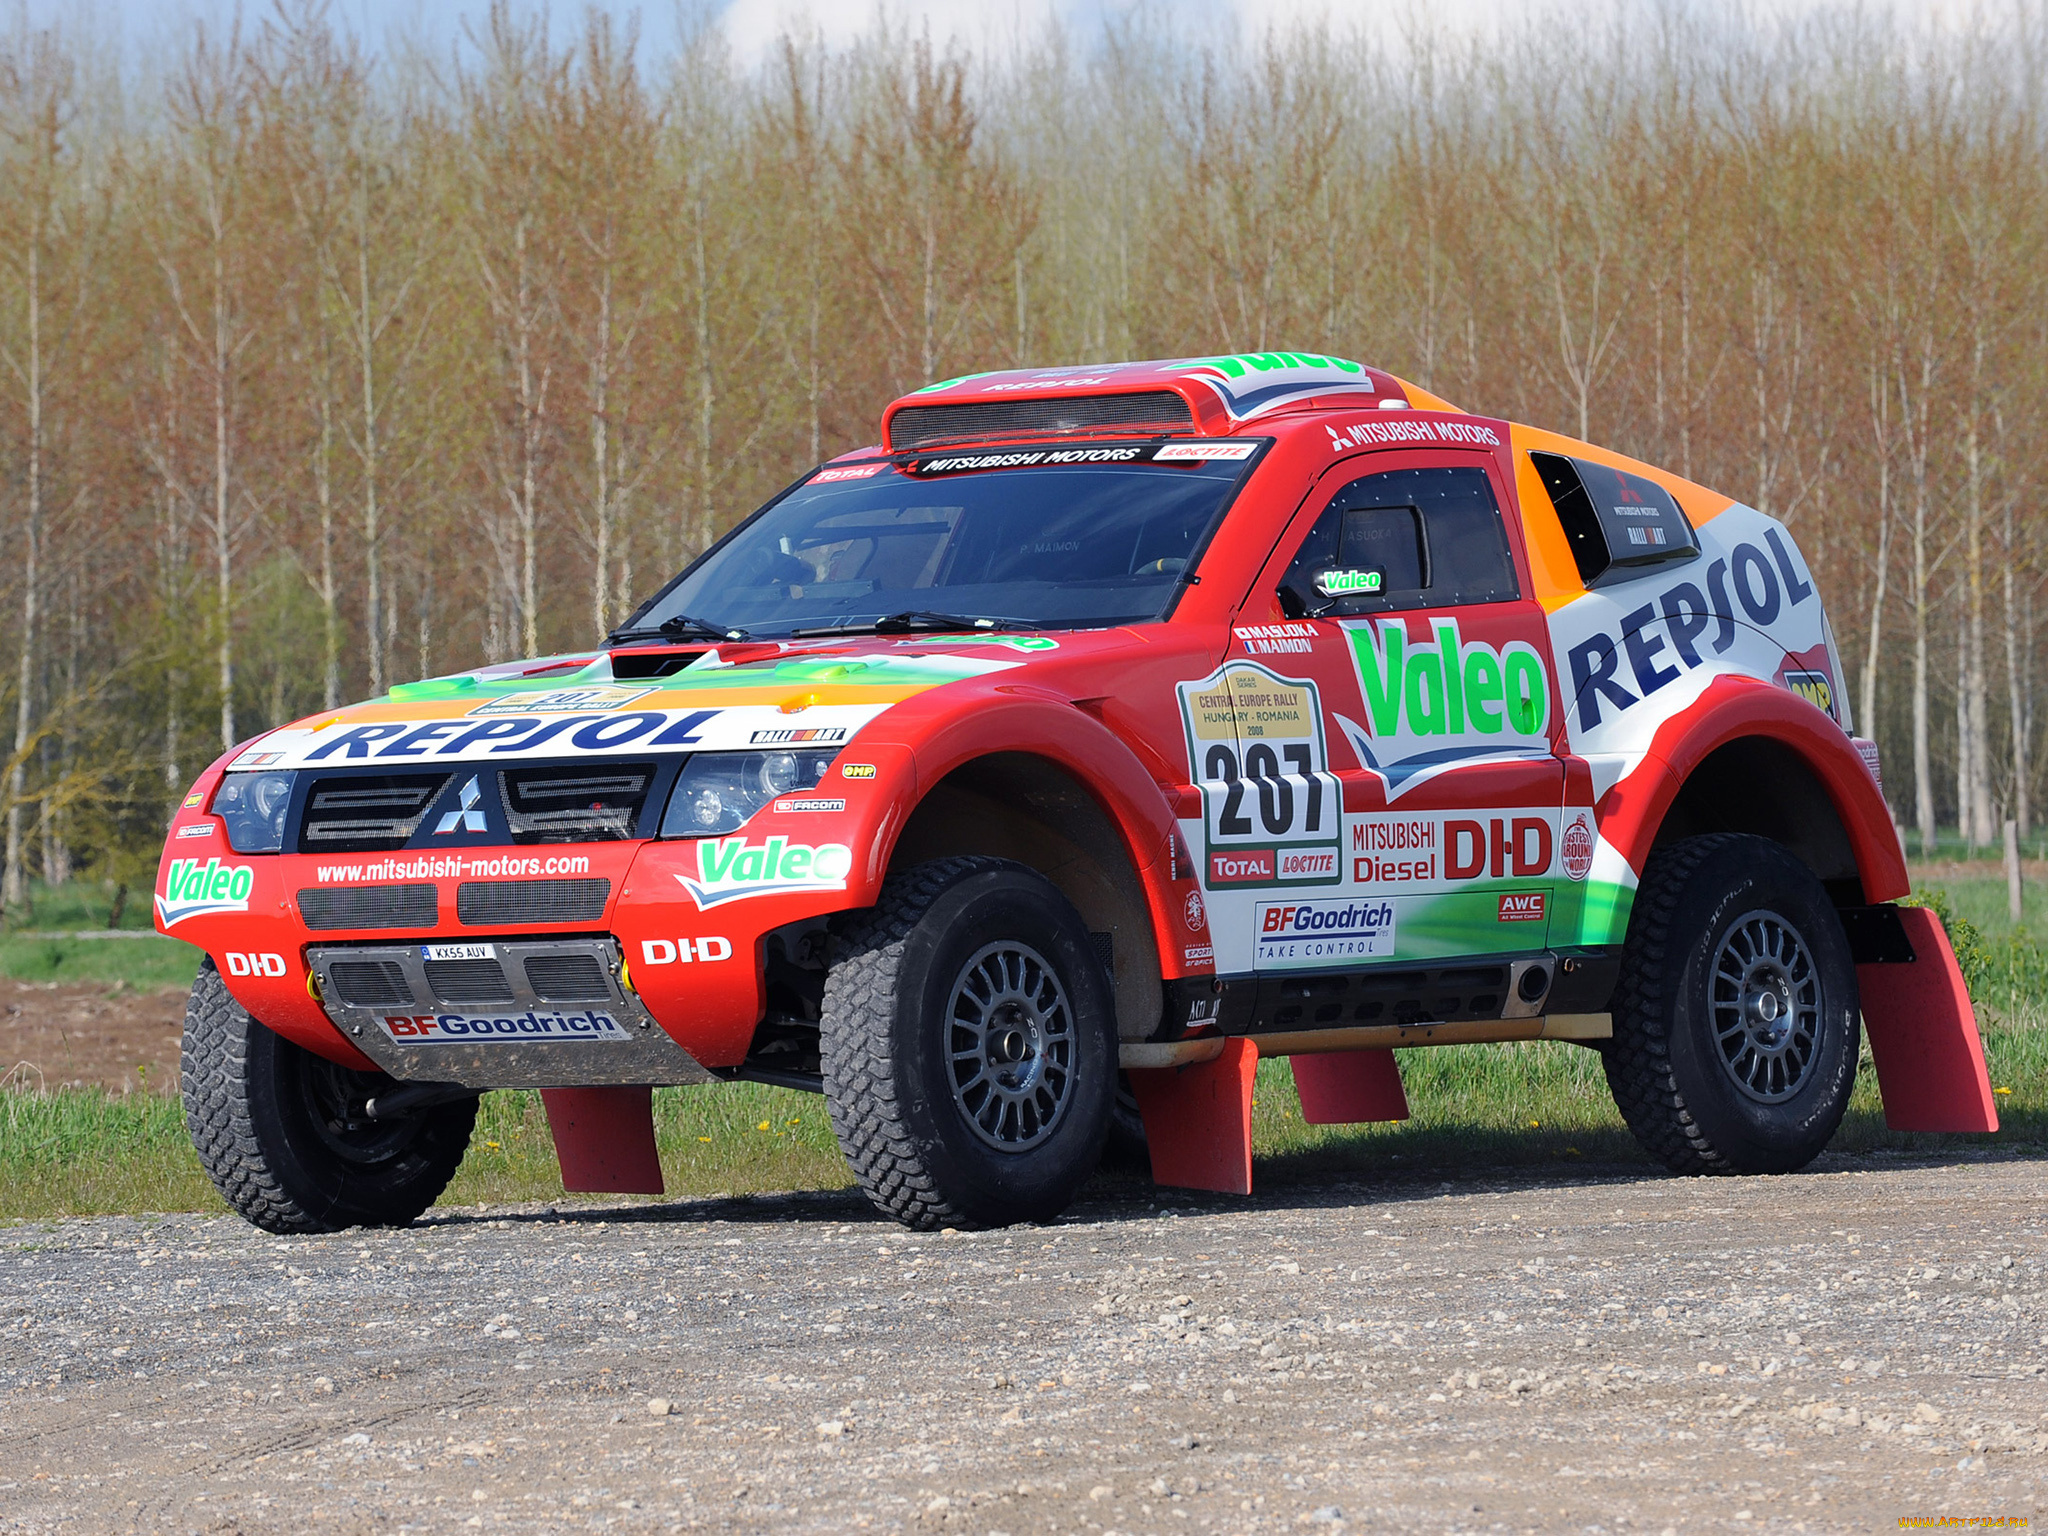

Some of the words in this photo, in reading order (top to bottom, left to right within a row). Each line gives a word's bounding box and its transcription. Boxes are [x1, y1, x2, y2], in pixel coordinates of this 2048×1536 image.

[981, 377, 1110, 391] REPSOL
[1346, 421, 1436, 446] MITSUBISHI
[1433, 421, 1500, 446] MOTORS
[922, 451, 1046, 472] MITSUBISHI
[1047, 448, 1140, 463] MOTORS
[1162, 445, 1247, 458] LOCTITE
[816, 467, 875, 482] TOTAL
[1034, 540, 1081, 554] MAIMON
[1325, 570, 1381, 589] Valeo
[1247, 623, 1320, 639] MASUOKA
[1568, 527, 1812, 734] REPSOL
[1257, 638, 1313, 654] MAIMON
[1349, 625, 1546, 737] Valeo
[539, 691, 604, 704] 207
[578, 702, 617, 710] RALLY
[1199, 694, 1238, 709] CENTRAL
[1240, 693, 1272, 707] EUROPE
[1274, 693, 1298, 707] RALLY
[1204, 711, 1249, 723] HUNGARY
[1256, 710, 1300, 722] ROMANIA
[303, 709, 725, 761] REPSOL
[1247, 725, 1264, 736] 2008
[1205, 743, 1323, 836] 207
[794, 800, 844, 811] FACOM
[1353, 822, 1435, 851] MITSUBISHI
[317, 854, 589, 882] www.mitsubishi-motors.com
[700, 837, 851, 882] Valeo
[1213, 857, 1271, 877] TOTAL
[1282, 854, 1334, 873] LOCTITE
[1353, 854, 1436, 883] Diesel
[166, 859, 252, 902] Valeo
[1502, 896, 1542, 911] AWC
[1262, 902, 1393, 933] BFGoodrich
[435, 947, 464, 959] KX55
[467, 946, 486, 958] AUV
[1187, 949, 1213, 957] SPORT
[1258, 945, 1295, 959] TAKE
[1305, 941, 1374, 957] CONTROL
[384, 1010, 615, 1036] BFGoodrich
